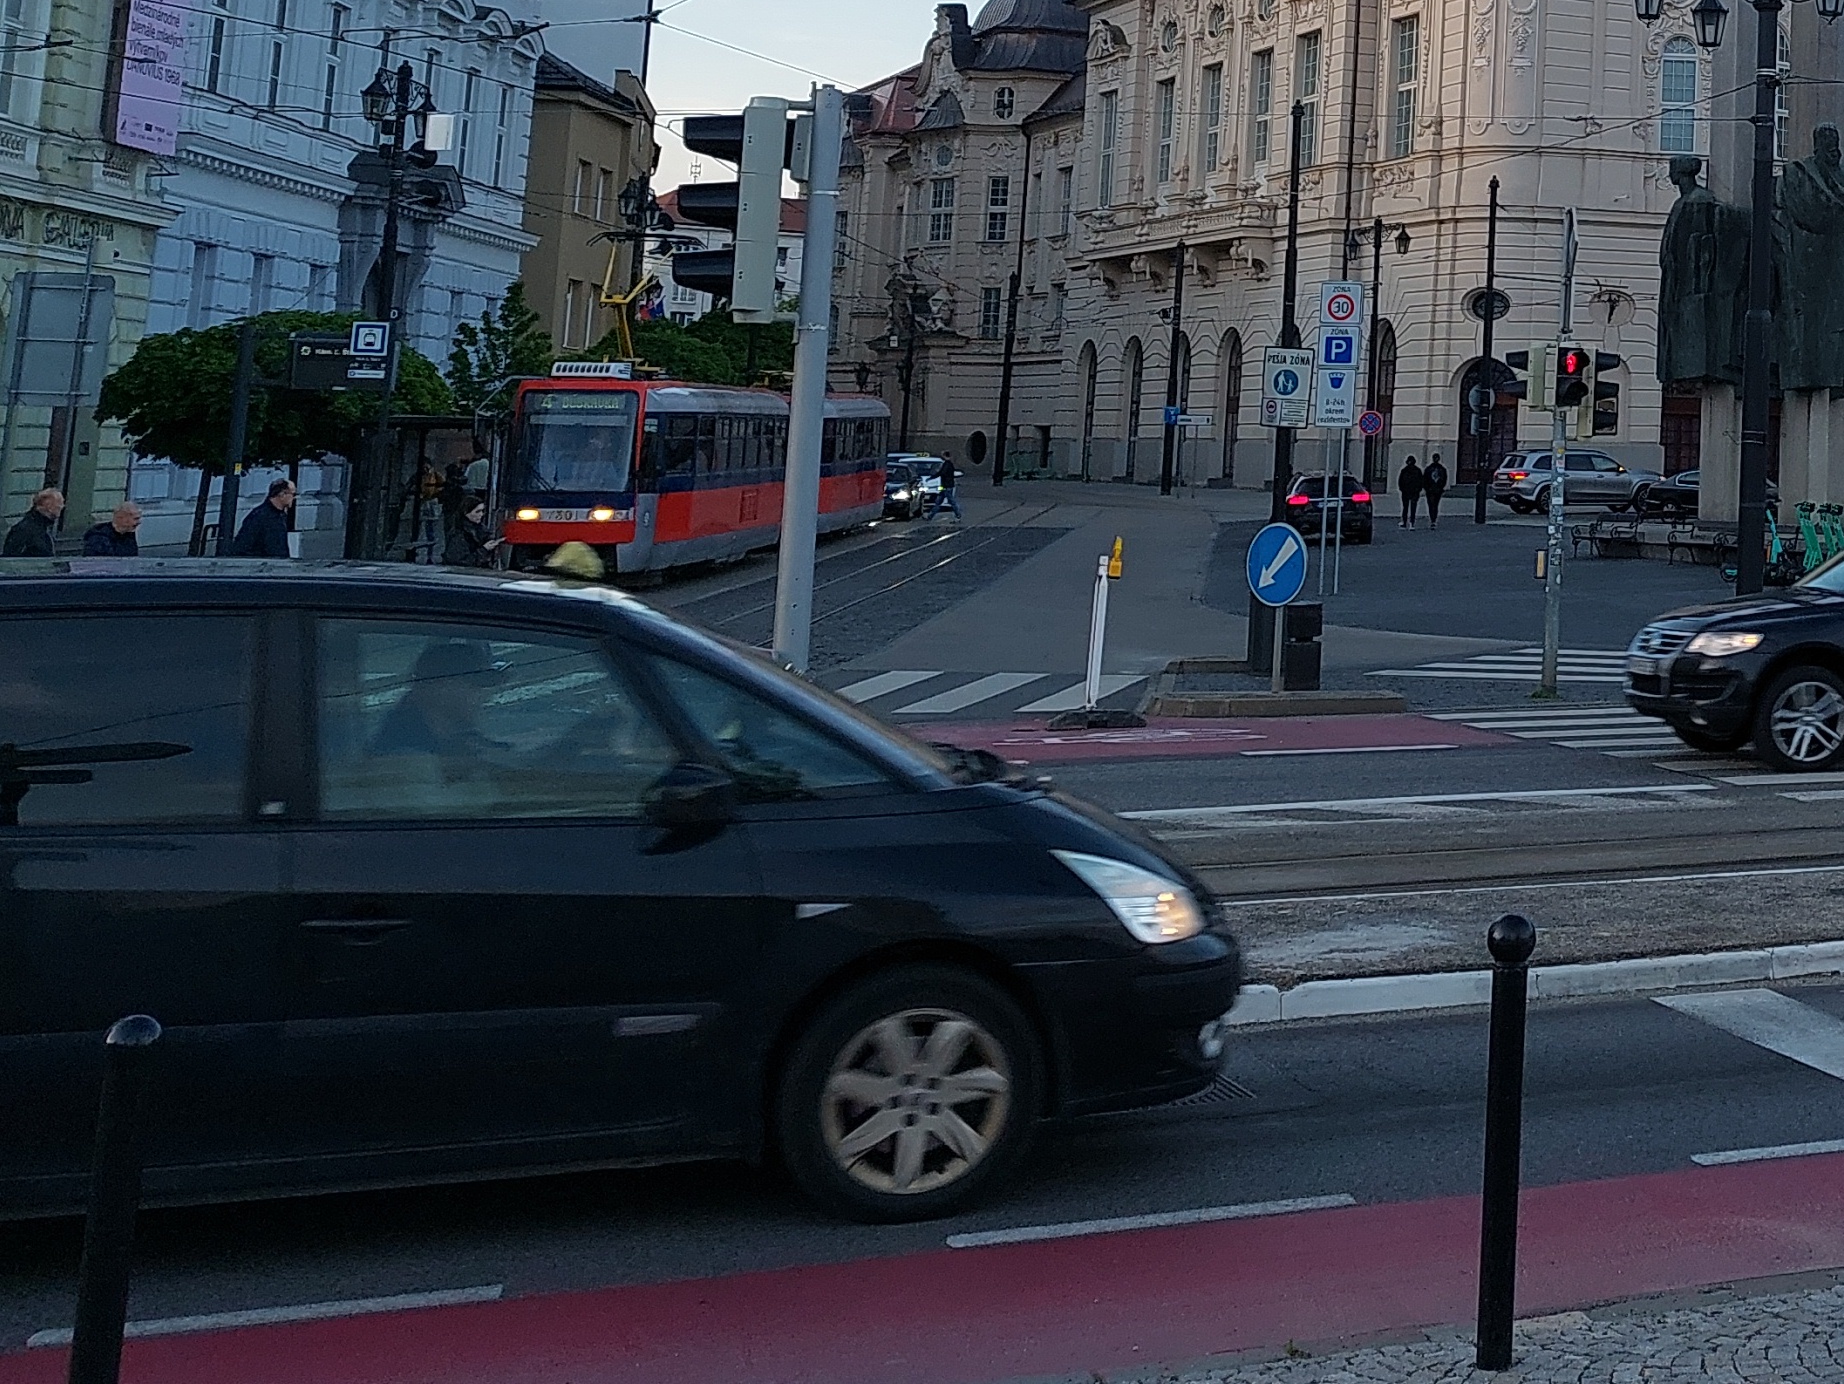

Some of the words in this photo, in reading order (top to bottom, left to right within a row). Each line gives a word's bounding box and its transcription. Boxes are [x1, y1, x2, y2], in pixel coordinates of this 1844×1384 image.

[1333, 301, 1349, 313] 30
[1331, 339, 1347, 360] P
[1289, 353, 1310, 366] ZÓNA
